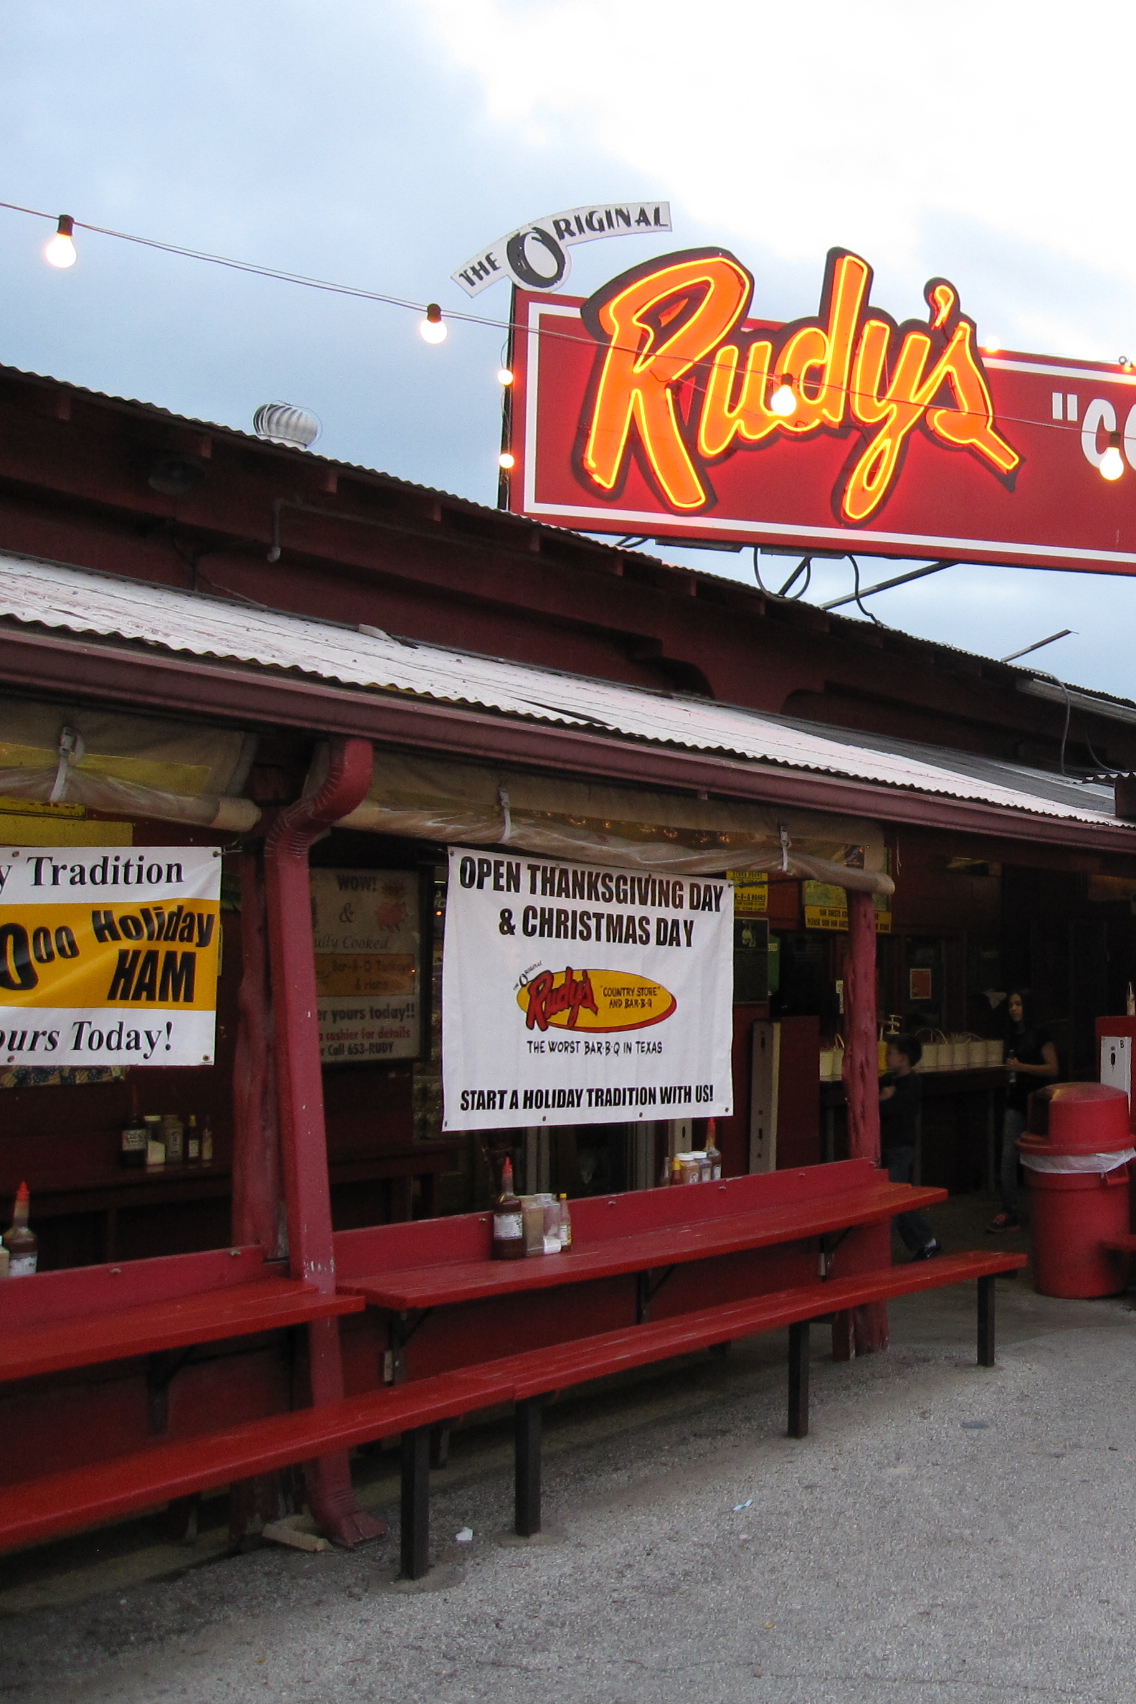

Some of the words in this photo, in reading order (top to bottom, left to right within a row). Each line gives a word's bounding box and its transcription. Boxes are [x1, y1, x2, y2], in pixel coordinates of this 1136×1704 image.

[458, 251, 503, 289] THE
[506, 204, 670, 289] ORIGINAL
[577, 249, 1023, 525] Rudy's
[26, 855, 186, 887] Tradition
[336, 875, 377, 891] WOW!
[459, 856, 521, 894] OPEN
[526, 864, 685, 910] THANKSGIVING
[688, 881, 724, 912] DAY
[91, 905, 216, 948] Holiday
[339, 902, 354, 923] &
[499, 908, 516, 936] &
[522, 905, 651, 946] CHRISTMAS
[655, 917, 695, 947] DAY
[314, 934, 338, 951] ully
[343, 935, 390, 949] Cooked
[106, 949, 197, 1003] HAM
[526, 966, 599, 1032] Rudy's
[609, 999, 623, 1009] AND
[331, 1008, 366, 1024] yours
[0, 1029, 61, 1052] urs
[70, 1021, 173, 1060] Today!
[326, 1028, 359, 1042] cashier
[361, 1027, 375, 1040] for
[377, 1026, 411, 1039] details
[526, 1040, 546, 1054] THE
[548, 1040, 581, 1054] WORST
[623, 1041, 632, 1054] IN
[635, 1041, 663, 1054] TEXAS
[327, 1043, 345, 1056] Call
[460, 1089, 507, 1111] START
[509, 1089, 519, 1110] A
[522, 1088, 583, 1110] HOLIDAY
[586, 1086, 656, 1107] TRADITION
[660, 1086, 694, 1105] WITH
[695, 1084, 714, 1103] US!
